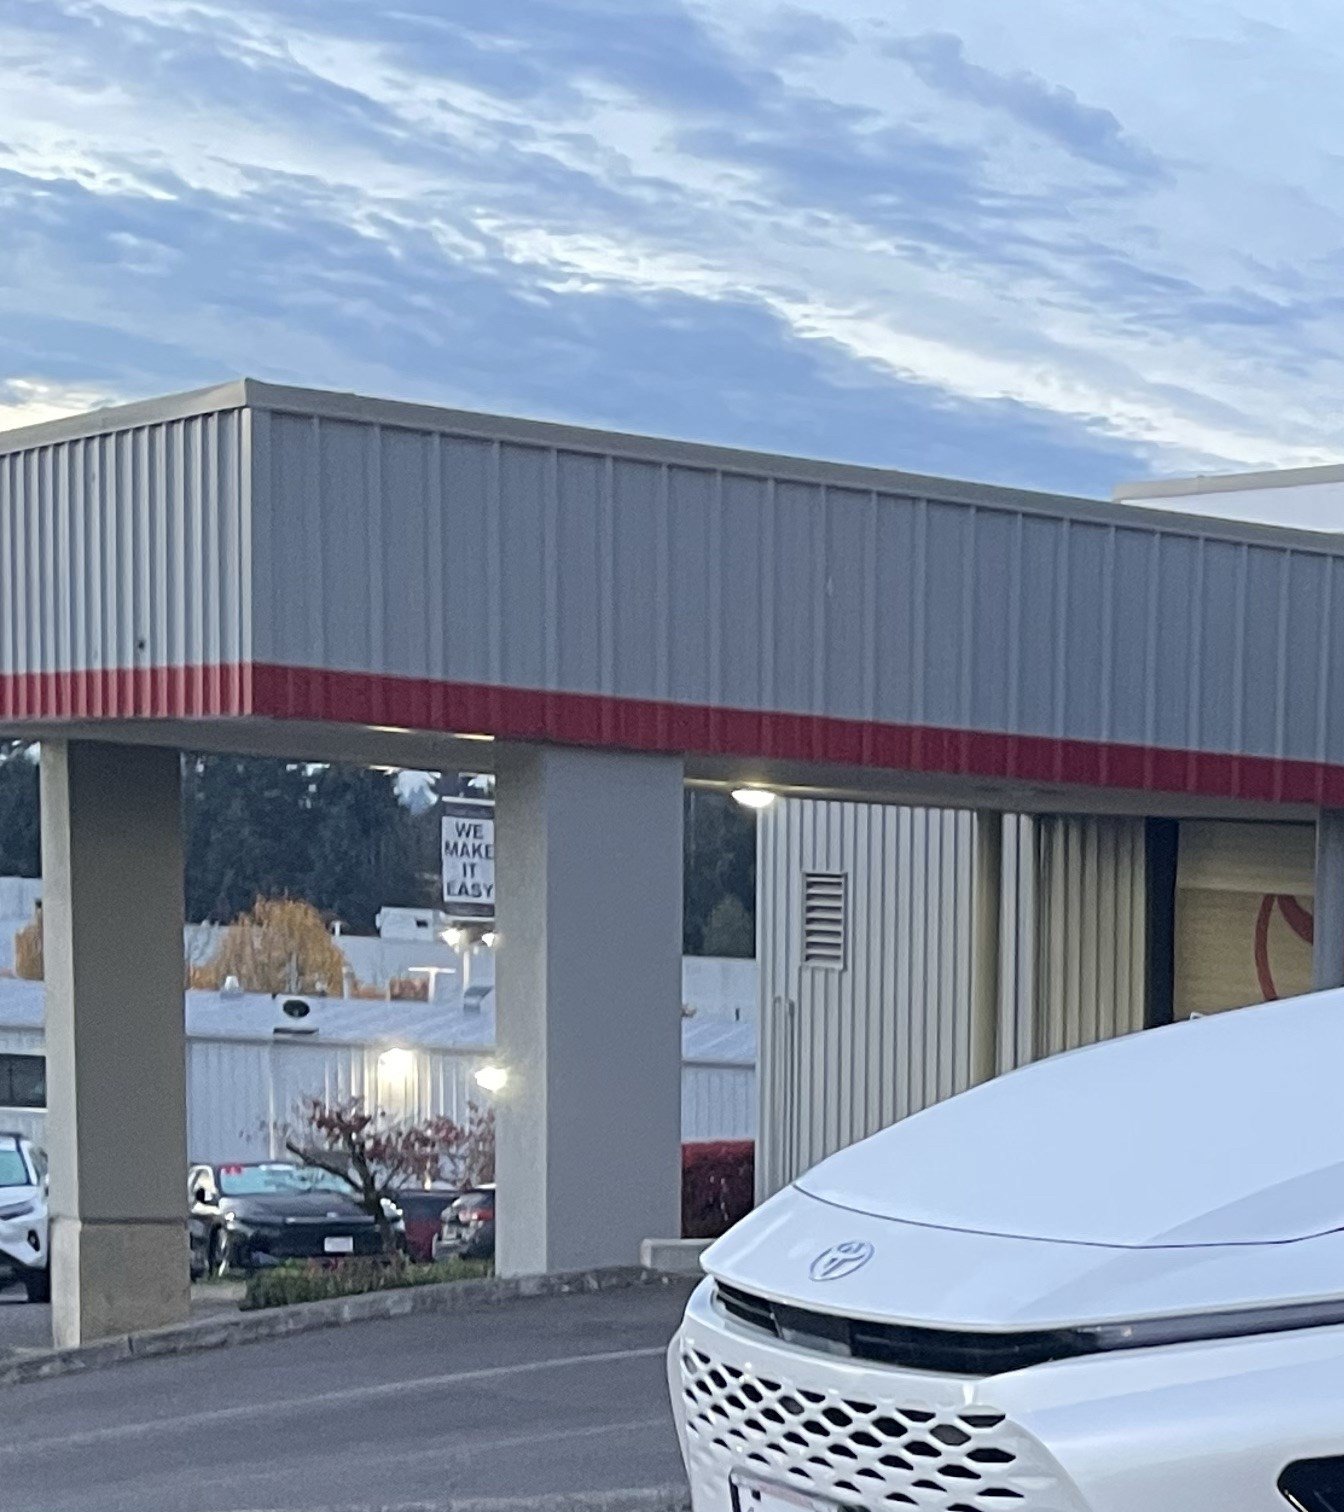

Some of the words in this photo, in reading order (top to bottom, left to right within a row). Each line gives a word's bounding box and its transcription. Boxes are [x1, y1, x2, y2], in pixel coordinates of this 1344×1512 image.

[455, 821, 484, 839] WE
[445, 840, 494, 860] MAKE
[462, 862, 477, 879] IT
[446, 881, 494, 898] EASY
